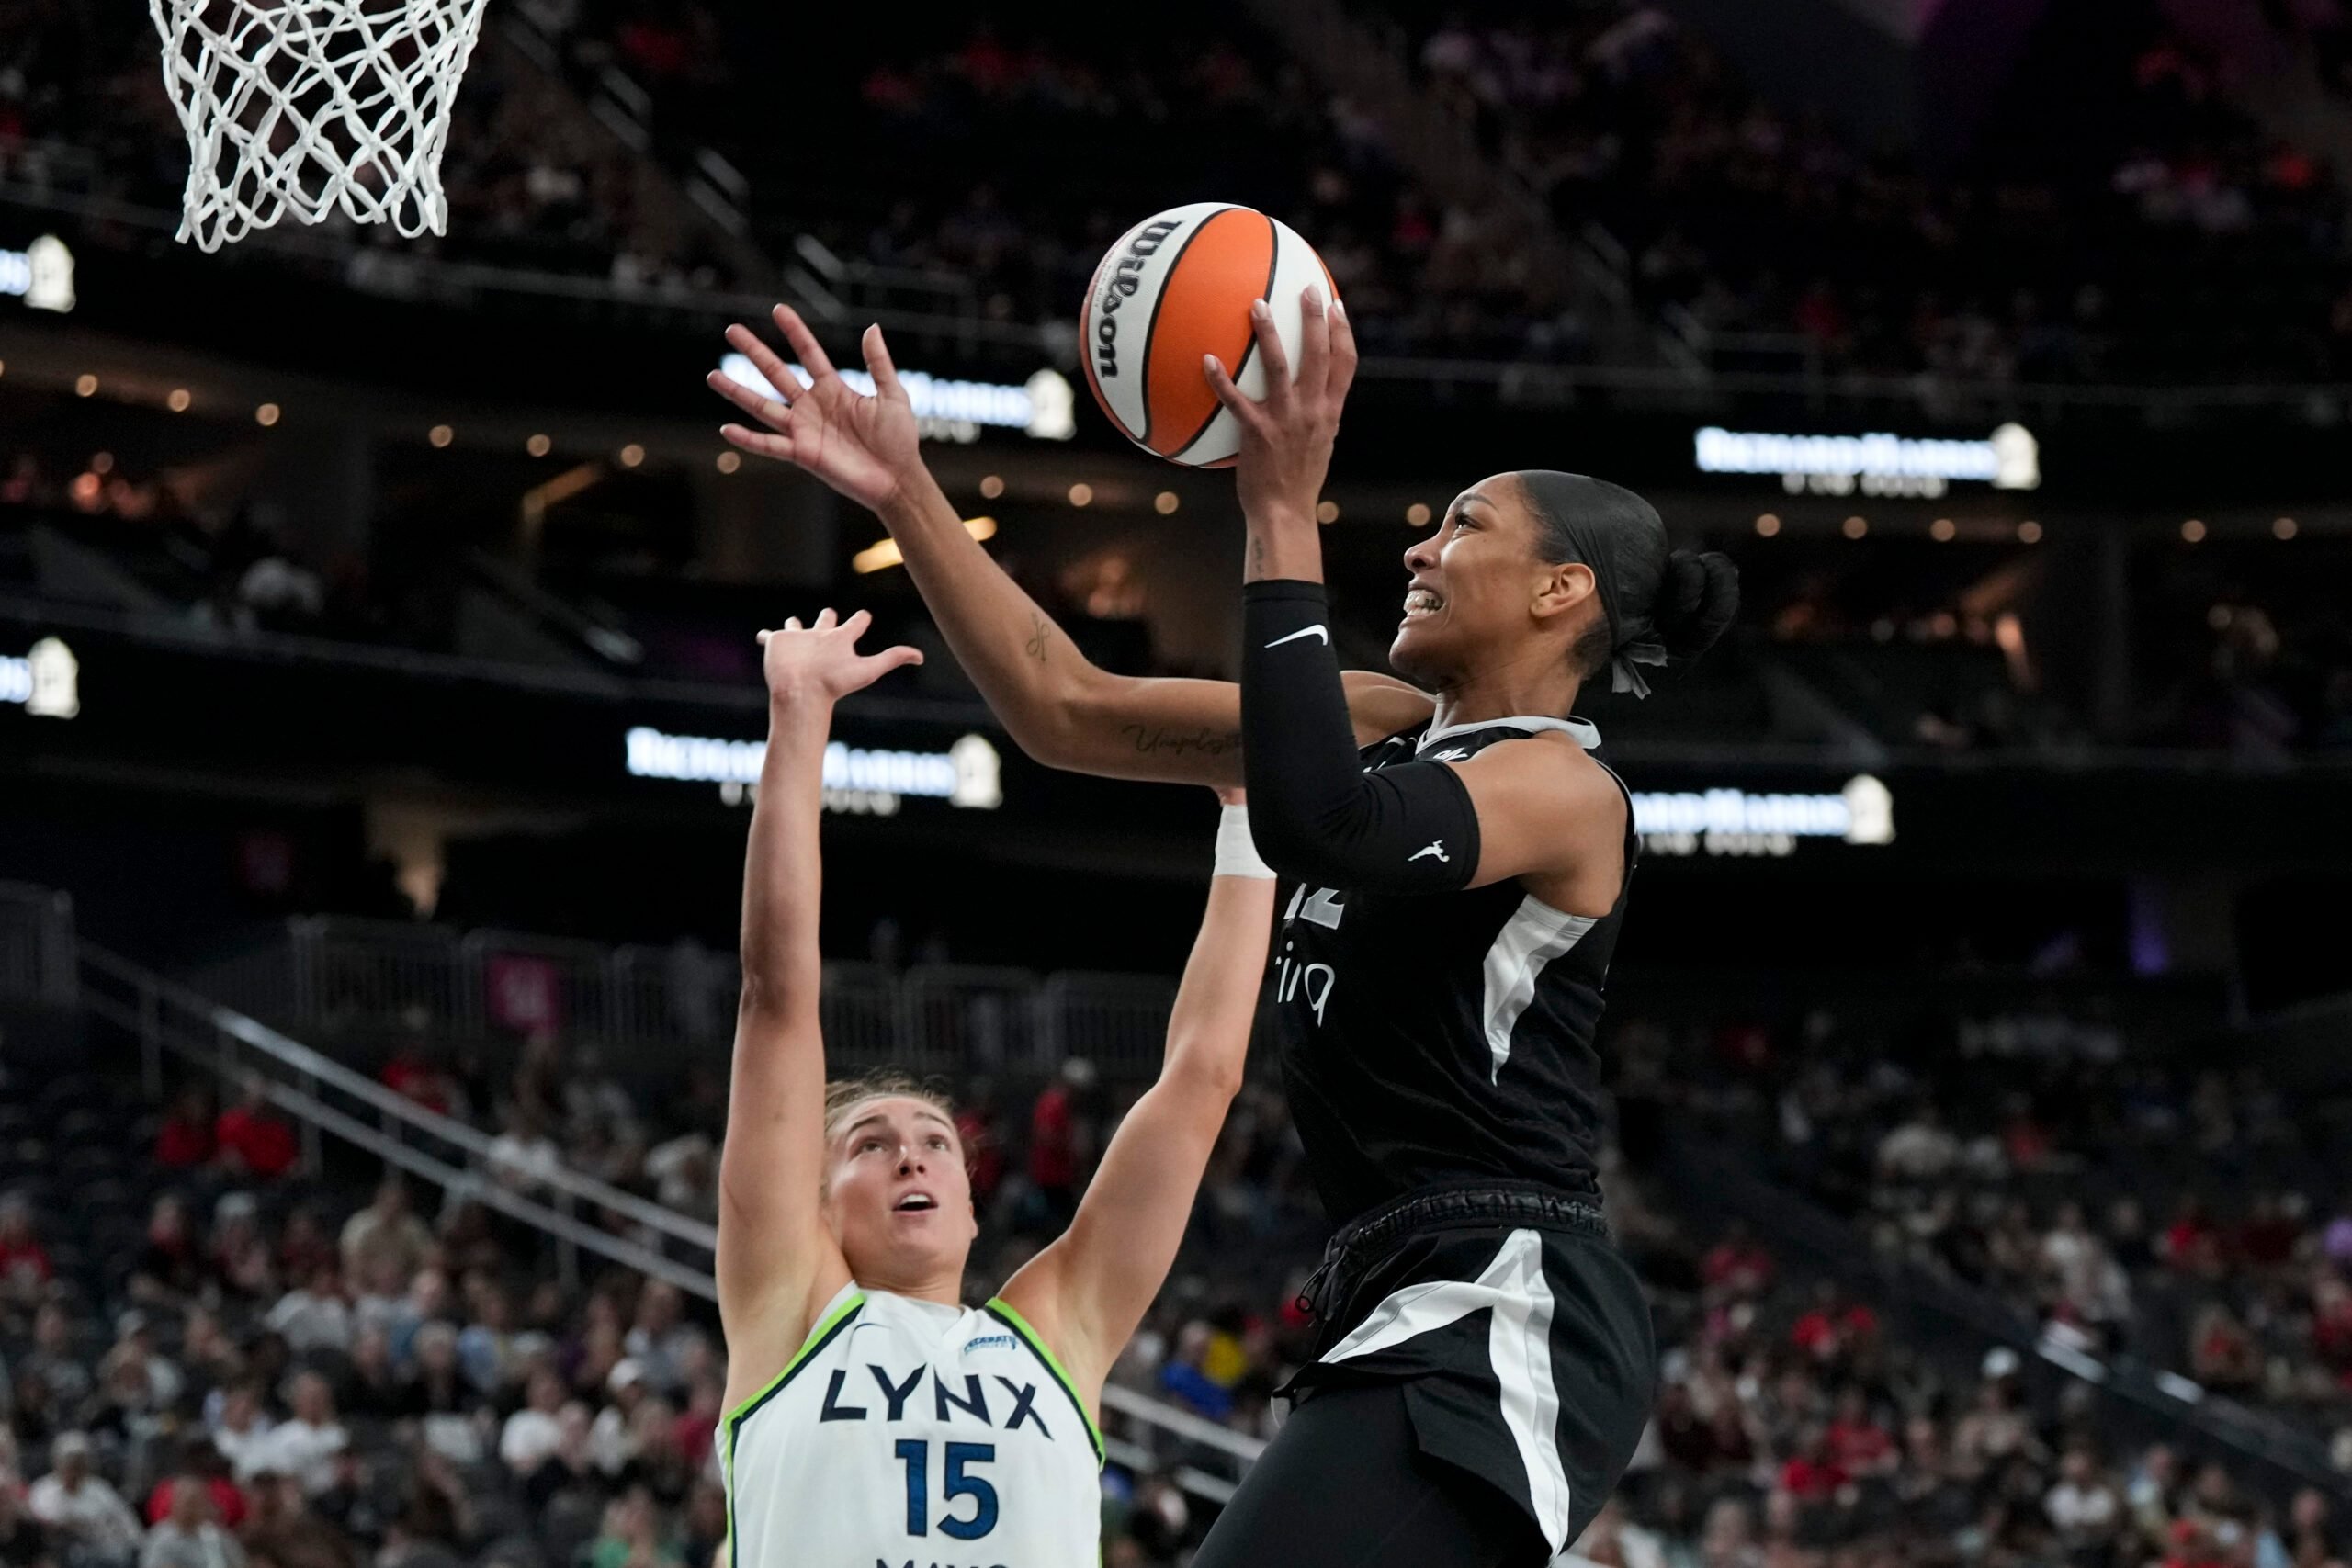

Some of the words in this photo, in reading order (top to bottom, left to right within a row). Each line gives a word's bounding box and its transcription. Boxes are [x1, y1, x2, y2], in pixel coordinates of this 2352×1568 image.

[1098, 220, 1185, 378] Wilson
[820, 1362, 1055, 1440] LYNX
[894, 1438, 999, 1540] 15
